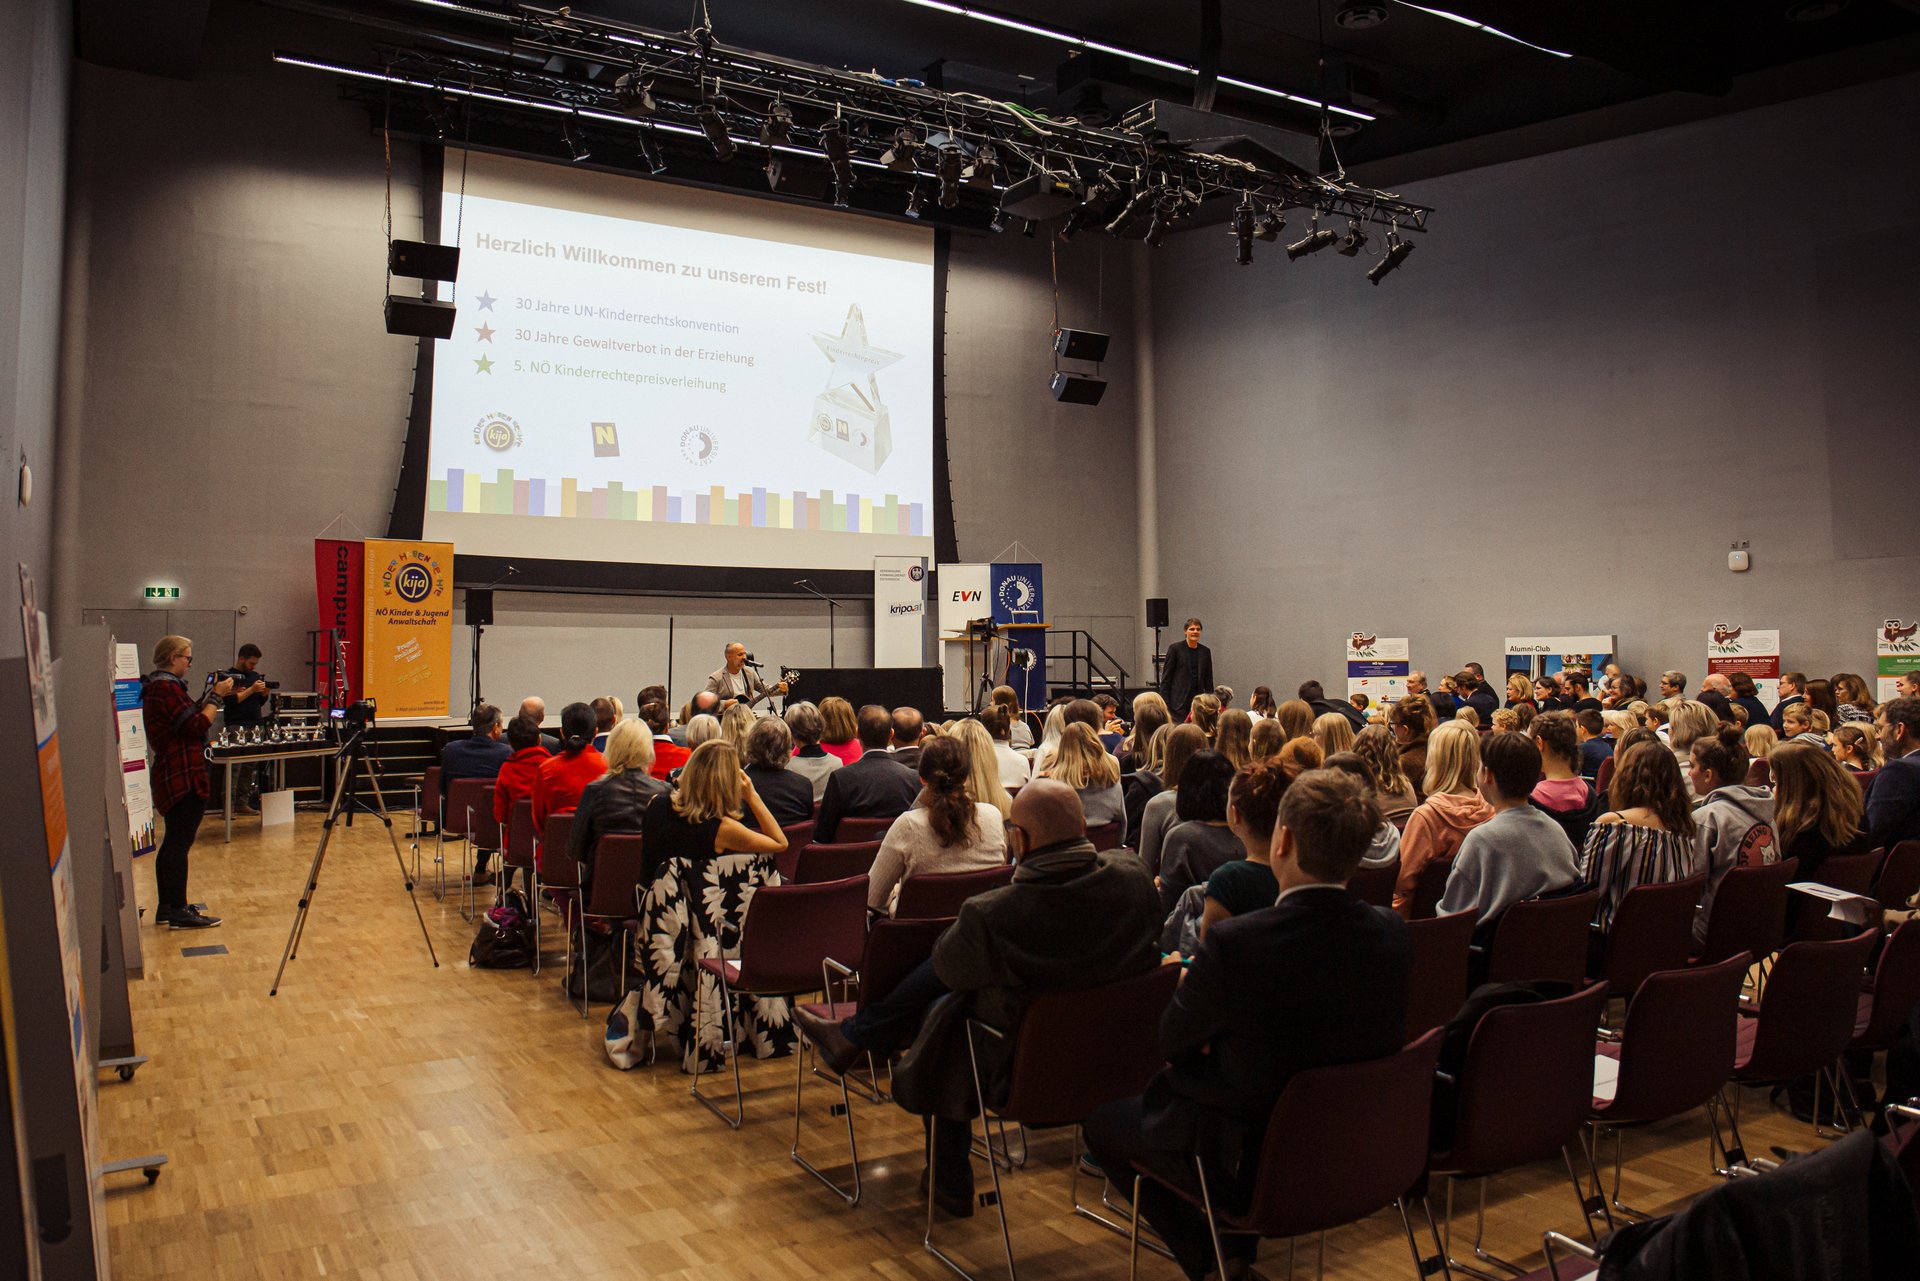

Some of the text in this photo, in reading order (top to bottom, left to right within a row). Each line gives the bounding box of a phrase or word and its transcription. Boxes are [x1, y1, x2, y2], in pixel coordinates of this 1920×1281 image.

[476, 232, 827, 295] Herzlich Willkommen zu unserem Fest!
[516, 297, 739, 334] 30 Jahre UN-Kinderrechtskonvention
[515, 328, 755, 367] 30 Jahre Gewaltverbot in der Erziehung
[514, 360, 727, 394] 5. NÖ Kinderrechtepreisverleihung
[595, 425, 616, 445] N
[402, 573, 426, 598] kija
[952, 590, 982, 602] EVN
[998, 575, 1017, 597] DONAU
[375, 608, 450, 619] NÖ Kinder & Jugend
[890, 602, 922, 615] kripo.at
[388, 617, 437, 626] Anwaltschaft
[1744, 826, 1767, 849] BEING
